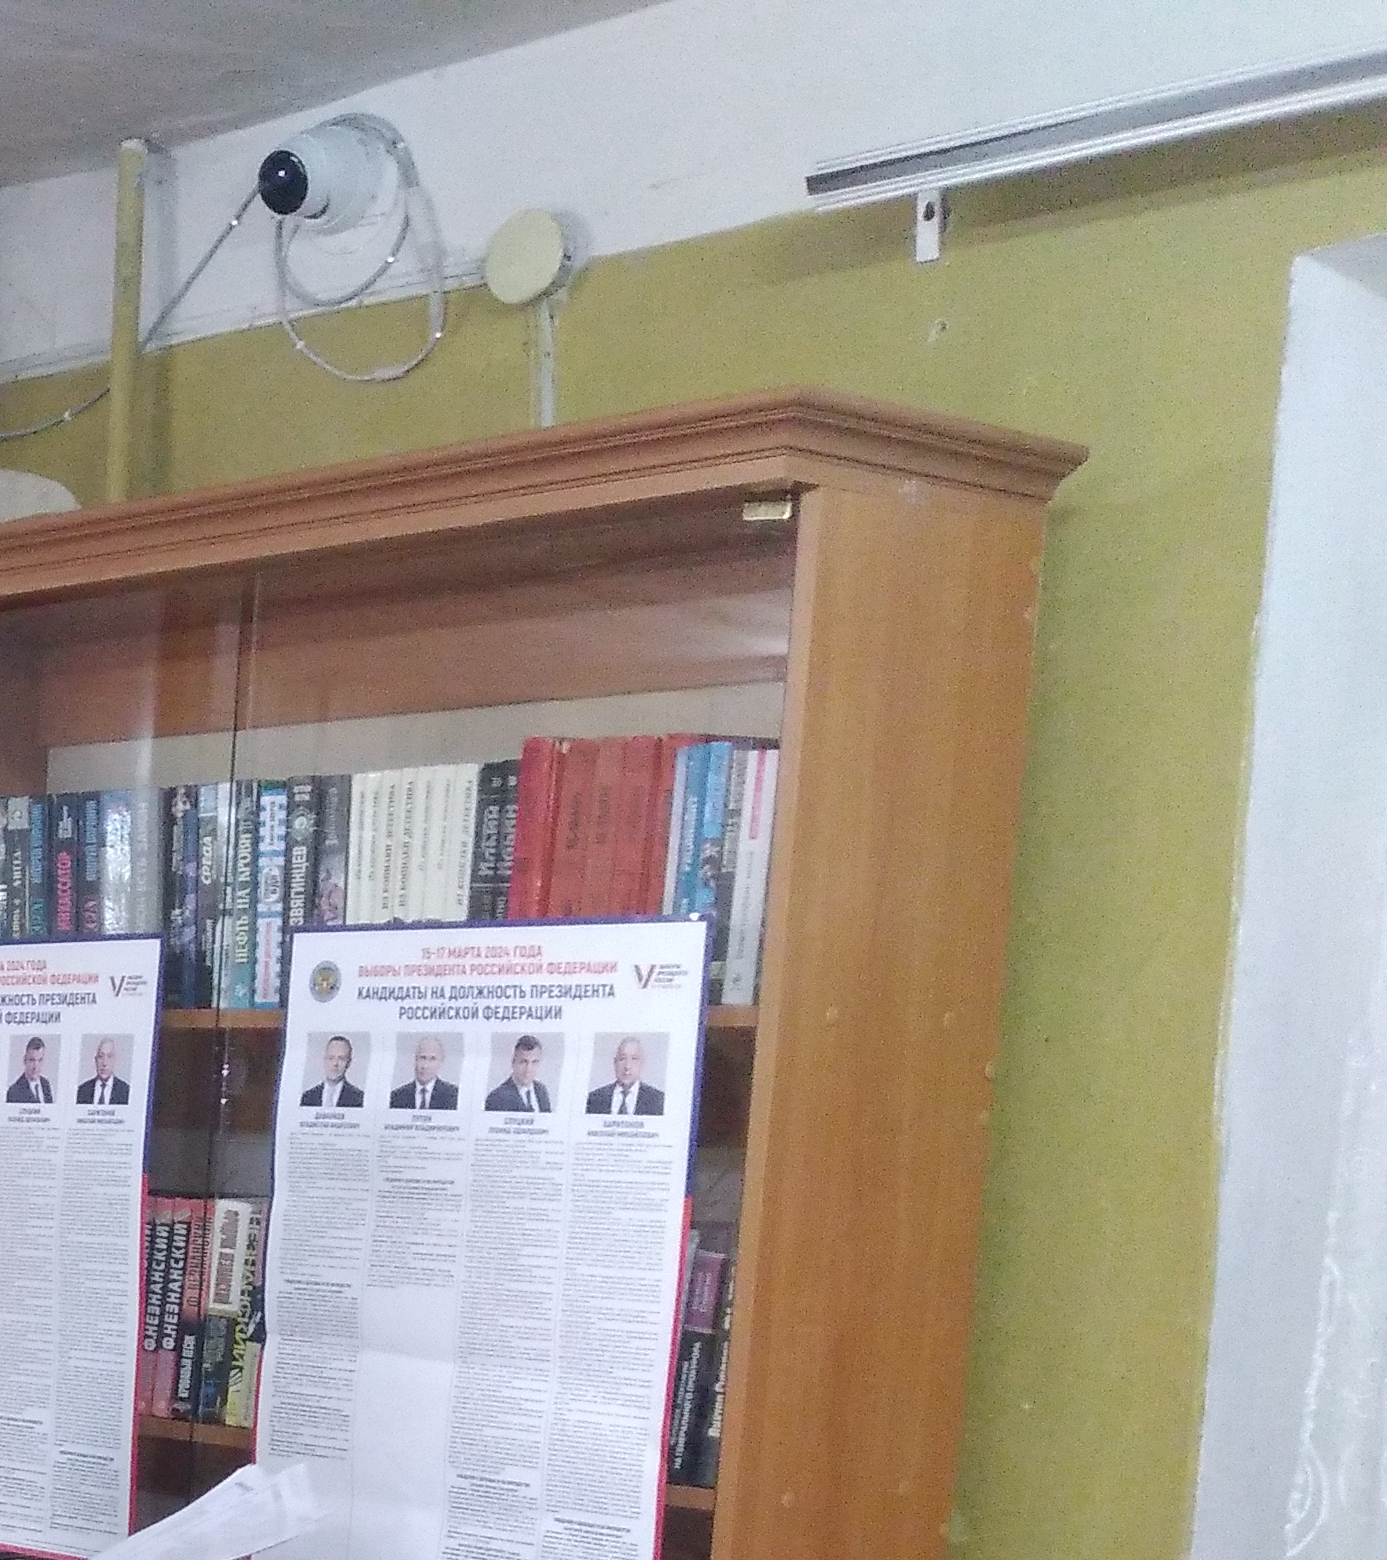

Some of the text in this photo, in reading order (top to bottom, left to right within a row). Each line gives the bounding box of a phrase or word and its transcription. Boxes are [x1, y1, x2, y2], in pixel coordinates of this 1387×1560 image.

[289, 846, 308, 926] ЗВЯГИНЦЕВ
[235, 889, 249, 908] НА
[235, 916, 249, 963] НЕФТЬ
[447, 946, 482, 959] МАРТА
[484, 946, 511, 959] 2024
[513, 945, 543, 959] ГОДА
[26, 959, 48, 971] ГОДА
[358, 960, 618, 977] ВЫБОРЫ ПРЕЗИДЕНТА РОССИЙСКОЙ ФЕДЕРАЦИИ
[49, 974, 99, 985] ФЕДЕРАЦИИ
[38, 992, 97, 1006] ПРЕЗИДЕНТА
[357, 983, 616, 1002] КАНДИДАТЫ НА ДОЛЖНОСТЬ ПРЕЗИДЕНТА
[4, 1010, 61, 1024] ФЕДЕРАЦИИ
[399, 1002, 563, 1022] РОССИЙСКОЙ ФЕДЕРАЦИИ
[144, 1224, 168, 1351] Ф.НЕЗНАНСКИЙ
[162, 1223, 187, 1350] Ф.НЕЗНАНСКИЙ
